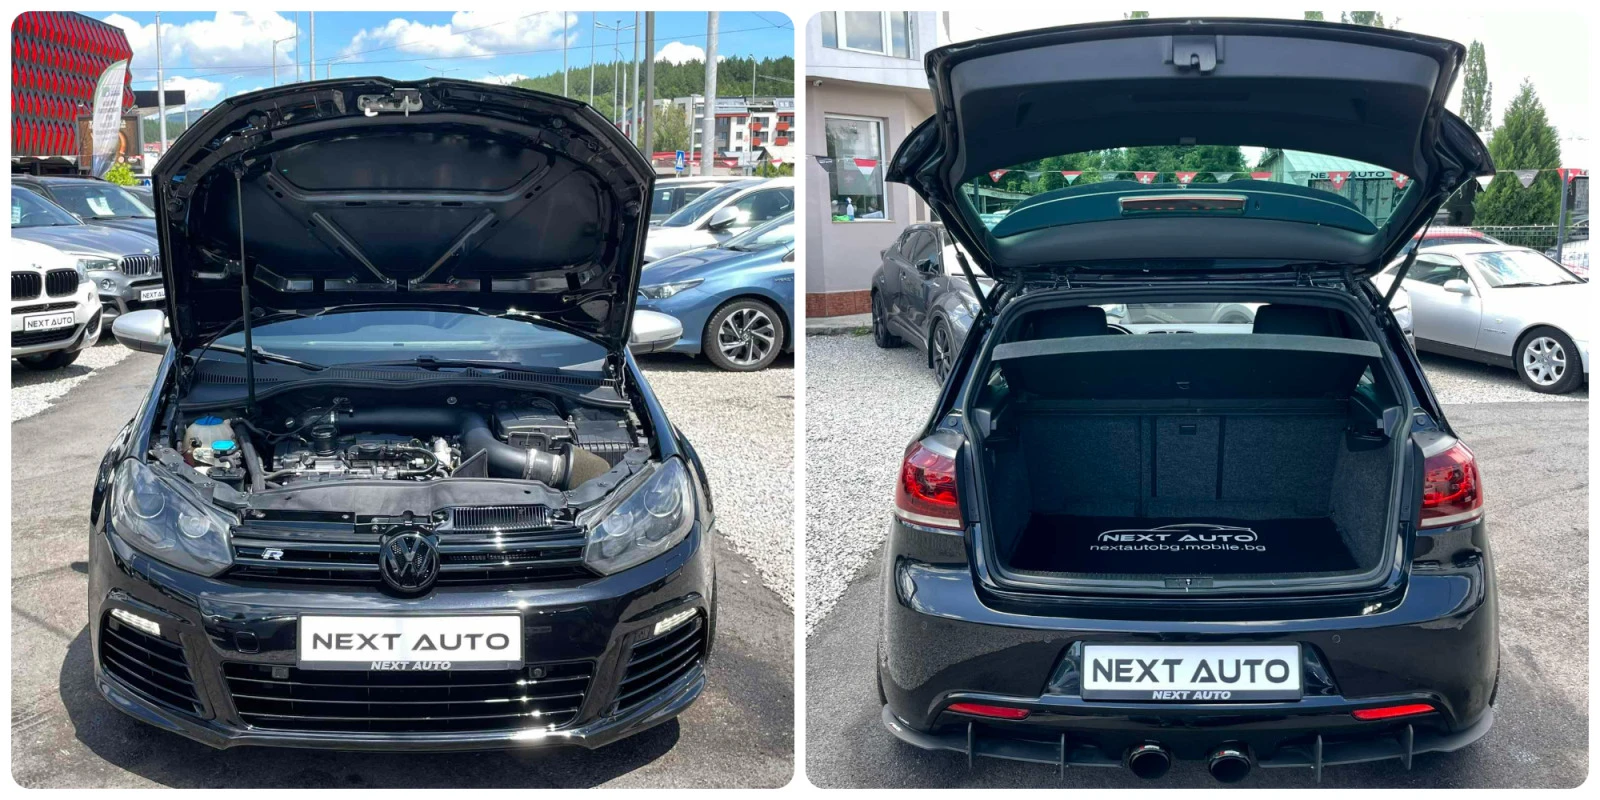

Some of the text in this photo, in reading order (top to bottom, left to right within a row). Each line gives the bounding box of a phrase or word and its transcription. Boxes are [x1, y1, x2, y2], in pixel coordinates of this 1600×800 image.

[157, 290, 165, 298] AU
[27, 316, 73, 328] NEXT AUTO
[1103, 534, 1254, 542] NEXT AUTO
[1090, 543, 1266, 551] nextautobg.mobile.bg
[261, 547, 285, 560] R
[312, 632, 510, 651] NEXT AUTO
[370, 660, 452, 671] NEXT AUTO
[1092, 657, 1290, 684] NEXT AUTO
[1152, 690, 1232, 700] NEXT AUTO
